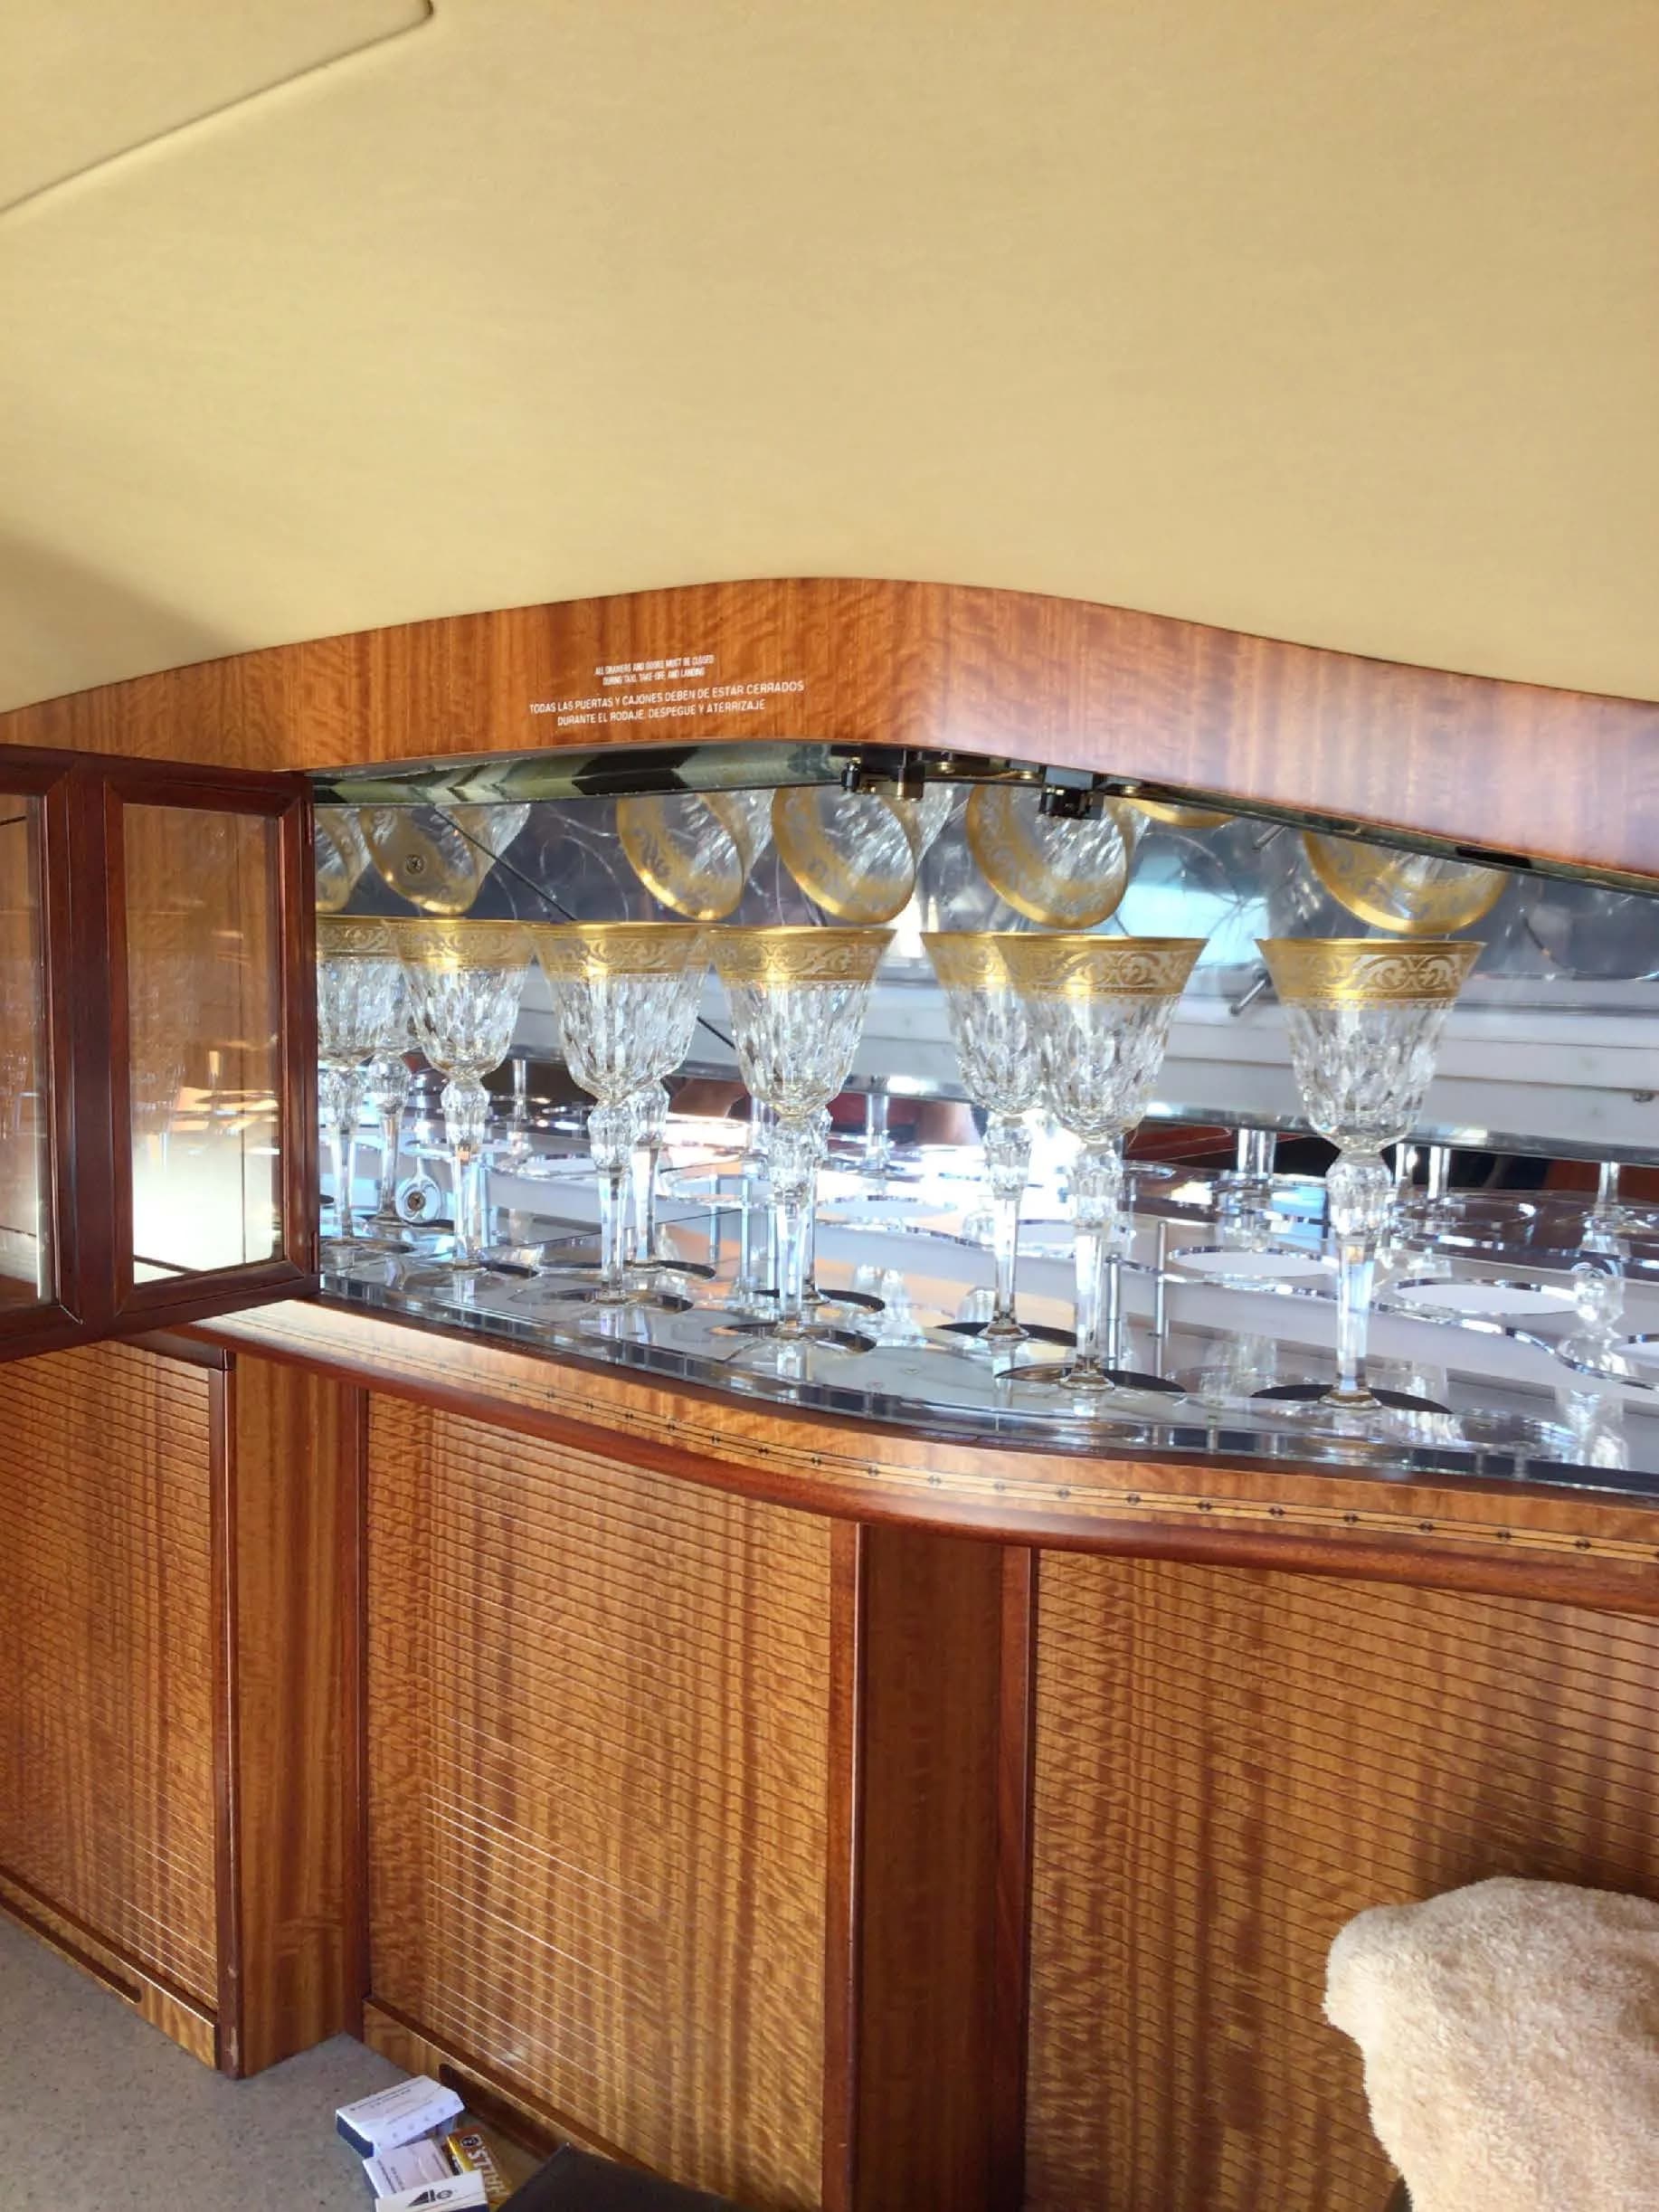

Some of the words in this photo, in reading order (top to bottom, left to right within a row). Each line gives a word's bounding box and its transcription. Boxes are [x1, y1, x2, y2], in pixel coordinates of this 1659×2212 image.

[529, 702, 556, 714] TODAS
[557, 700, 574, 712] LAS
[574, 697, 612, 710] PUERTAS
[614, 696, 621, 707] Y
[621, 692, 663, 705] CAJONES
[665, 689, 696, 702] DEBEN
[697, 687, 710, 698] DE
[712, 685, 744, 698] ESTAR
[746, 680, 804, 695] CERRADOS
[557, 713, 596, 726] DURANTE
[598, 712, 608, 724] EL
[648, 705, 696, 718] DESPEGUE
[698, 705, 705, 716] Y
[706, 698, 766, 713] ATERRIZAJE
